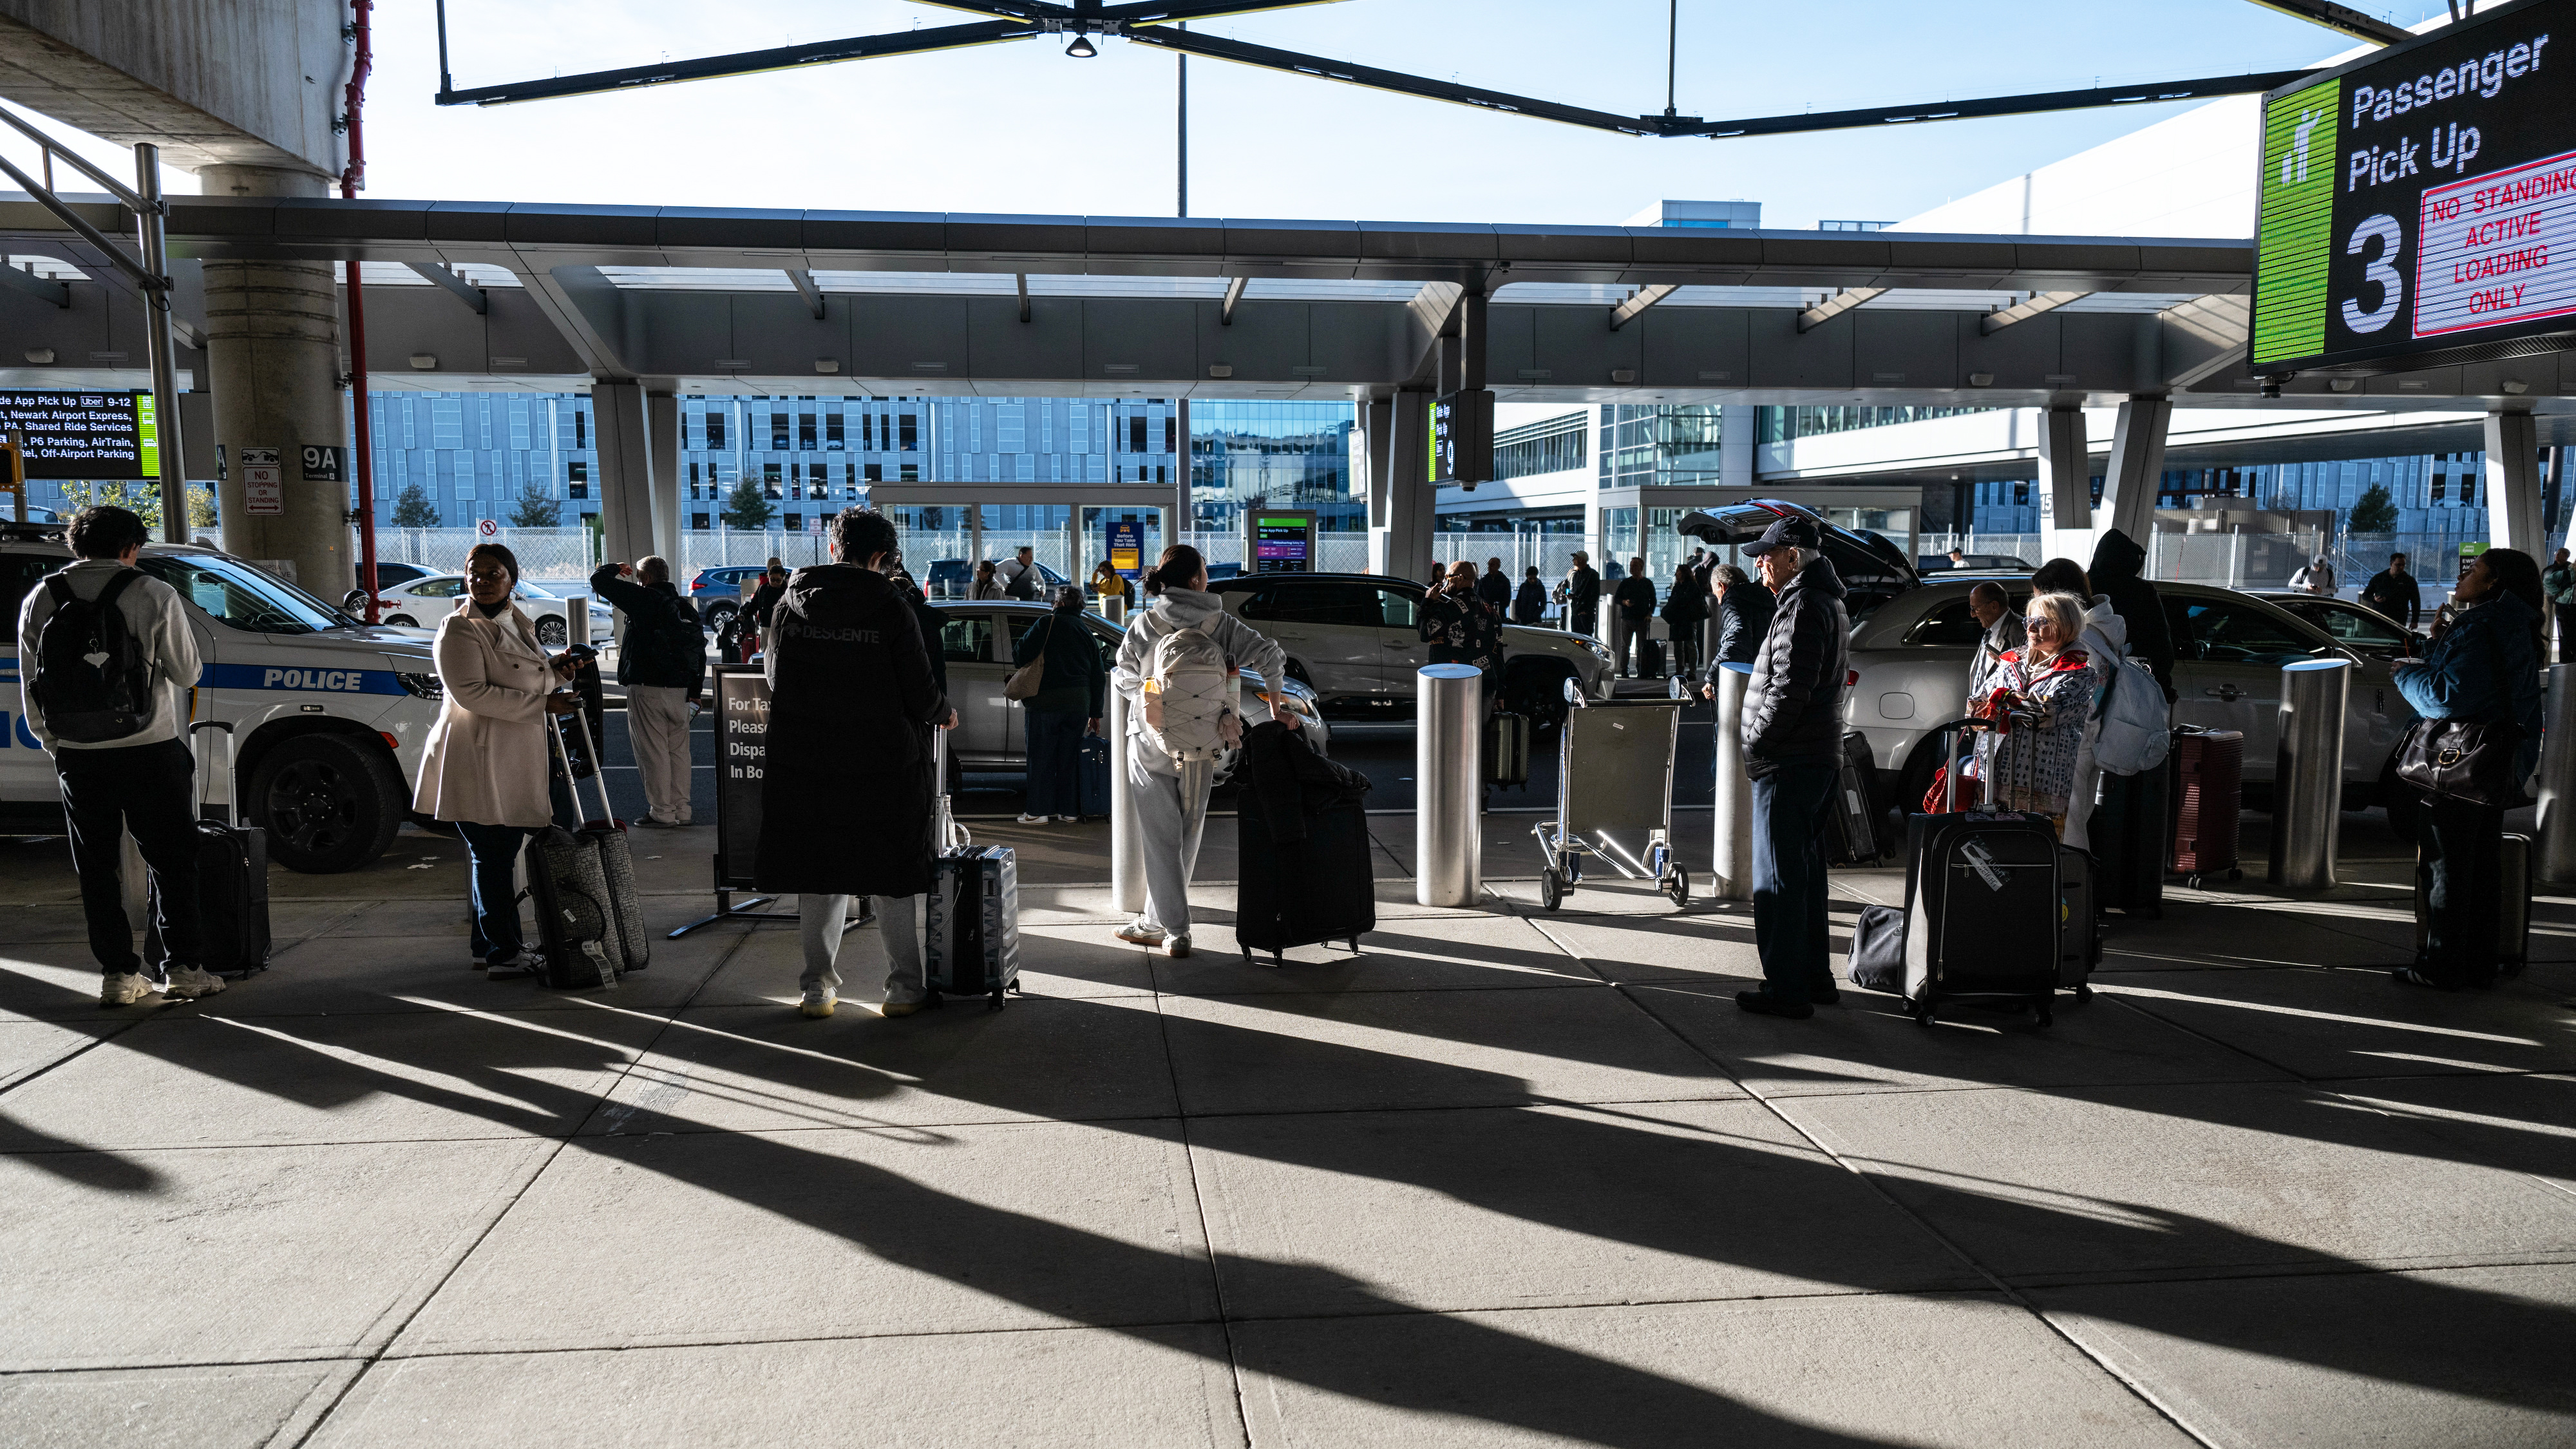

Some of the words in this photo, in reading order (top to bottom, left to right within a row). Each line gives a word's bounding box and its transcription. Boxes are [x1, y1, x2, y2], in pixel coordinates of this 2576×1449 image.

[2352, 33, 2548, 129] Passenger
[2348, 137, 2420, 192] Pick
[2431, 122, 2480, 173] Up
[2432, 198, 2460, 223] NO
[2464, 212, 2541, 249] ACTIVE
[2342, 214, 2402, 334] 3
[2454, 245, 2548, 283] LOADING
[2468, 283, 2526, 314] ONLY
[14, 395, 35, 407] App
[37, 396, 59, 405] Pick
[62, 397, 77, 407] Up
[82, 397, 102, 406] Uber
[108, 398, 131, 406] 9-12
[10, 410, 48, 419] Newark
[52, 411, 86, 421] Airport
[89, 411, 132, 422] Express,
[25, 422, 61, 431] Shared
[64, 422, 87, 431] Ride
[90, 422, 133, 431] Services
[30, 437, 44, 446] P6
[47, 437, 88, 448] Parking,
[91, 437, 134, 448] AirTrain,
[41, 448, 95, 459] Off-Airport
[97, 450, 135, 460] Parking
[303, 447, 337, 469] 9A
[1447, 439, 1454, 475] 9
[254, 471, 269, 480] NO
[2040, 494, 2052, 511] 15
[802, 625, 880, 643] DESCENTE
[1472, 655, 1489, 667] GUESS
[263, 668, 362, 690] POLICE
[728, 697, 750, 710] For
[752, 697, 771, 711] Ta
[730, 765, 743, 778] In
[746, 765, 764, 779] Bo
[1977, 862, 1998, 887] WEIGHT
[1988, 858, 2005, 878] LIGHT
